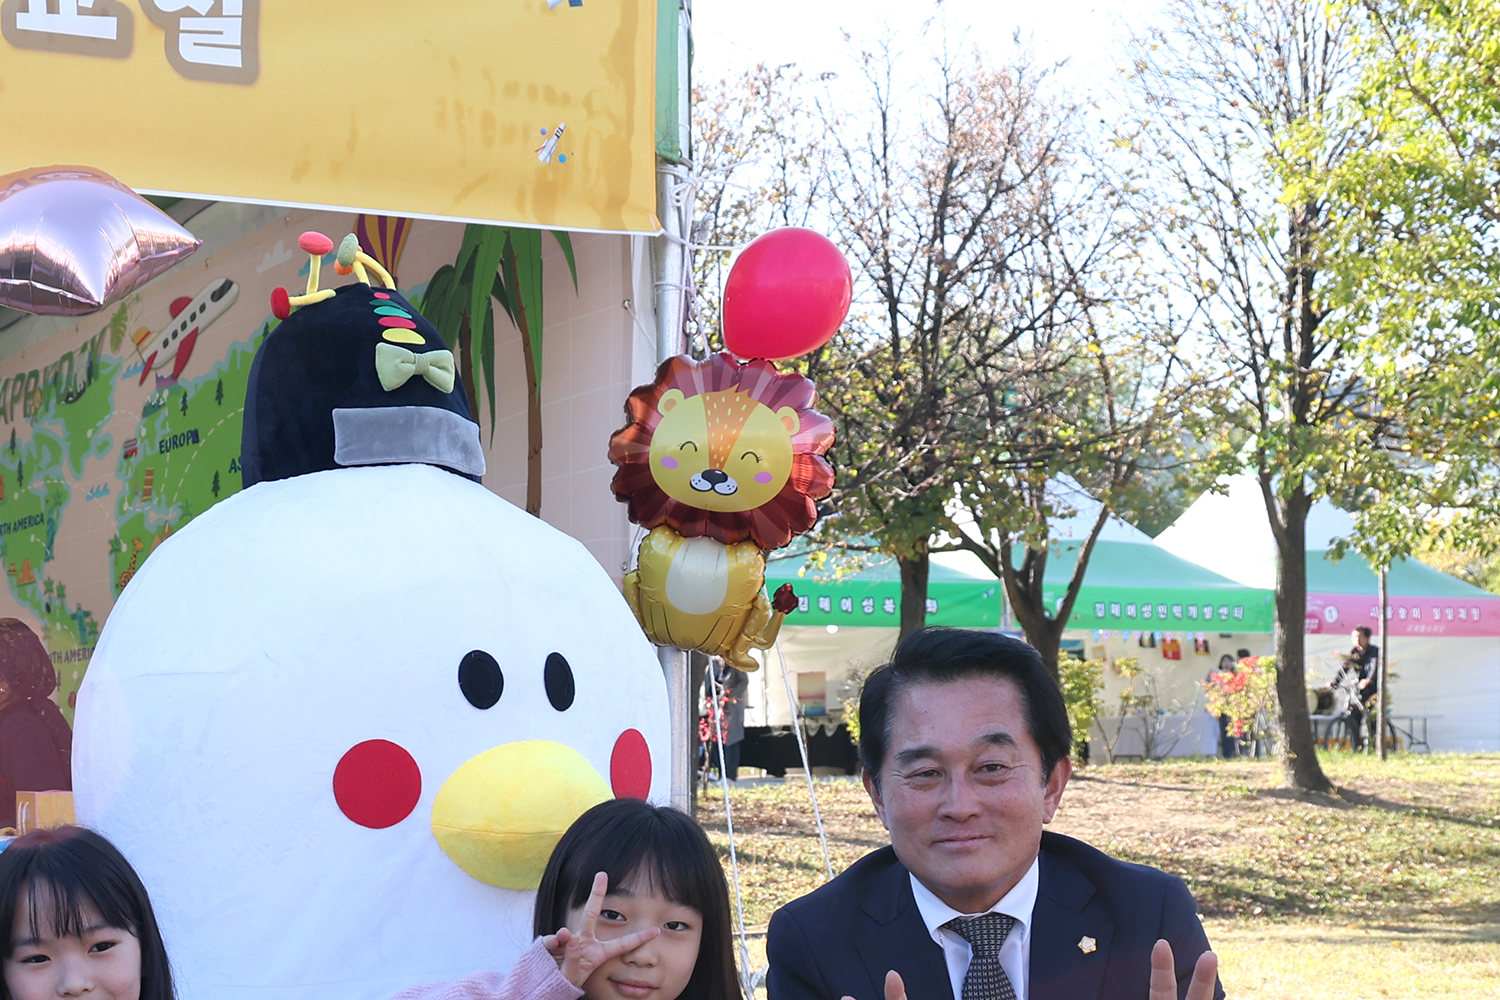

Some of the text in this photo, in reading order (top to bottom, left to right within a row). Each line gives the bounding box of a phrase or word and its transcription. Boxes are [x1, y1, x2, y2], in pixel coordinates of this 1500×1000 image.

[159, 428, 199, 454] EUROP
[12, 512, 45, 533] AMERICA
[64, 647, 95, 663] AMERI
